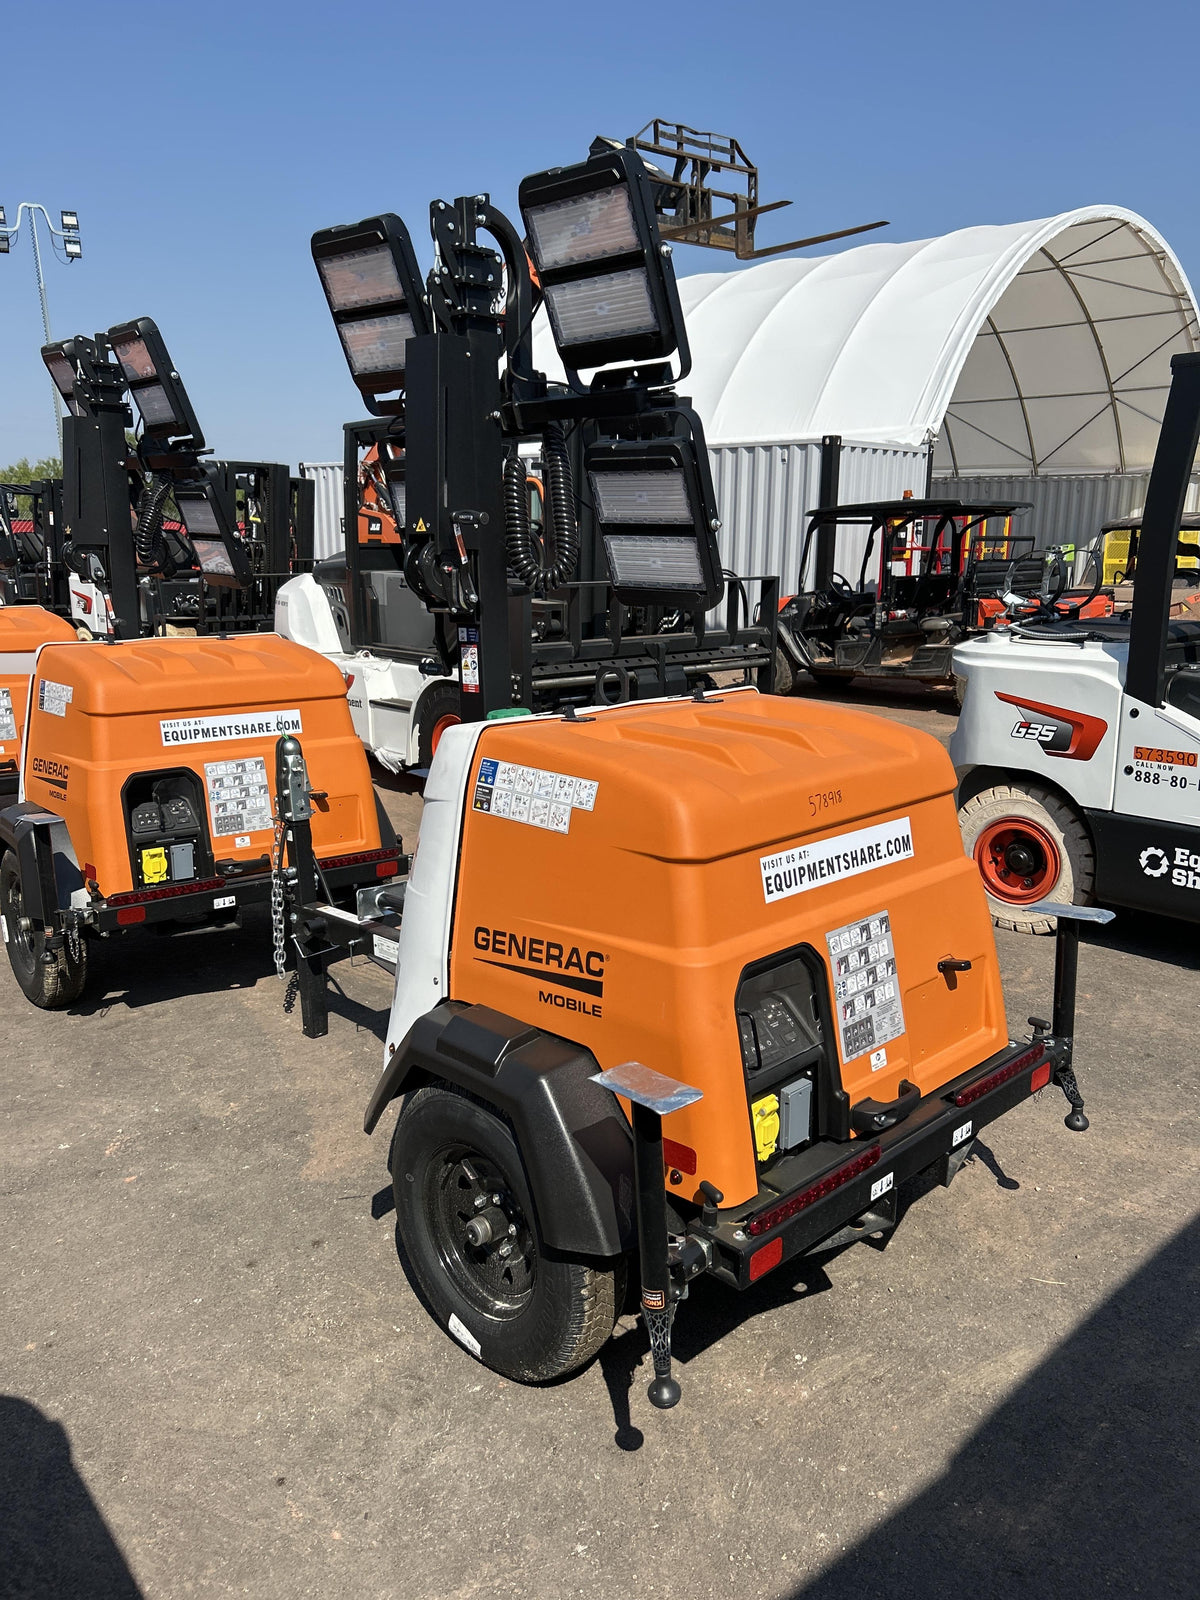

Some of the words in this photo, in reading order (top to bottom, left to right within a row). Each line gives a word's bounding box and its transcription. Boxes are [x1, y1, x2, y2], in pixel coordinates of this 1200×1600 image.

[162, 720, 180, 728] VISIT
[164, 719, 300, 742] EQUIPMENTSHARE.COM
[1135, 746, 1196, 767] 573590
[1136, 761, 1153, 769] CALL
[33, 757, 69, 779] GENERAC
[1135, 770, 1200, 791] 888-80-
[49, 790, 67, 801] MOBILE
[808, 790, 843, 817] 578918
[762, 857, 783, 871] VISIT
[786, 853, 796, 864] US
[799, 850, 810, 861] AT:
[765, 834, 911, 895] EQUIPMENTSHARE.COM
[474, 926, 605, 978] GENERAC
[539, 990, 602, 1018] MOBILE
